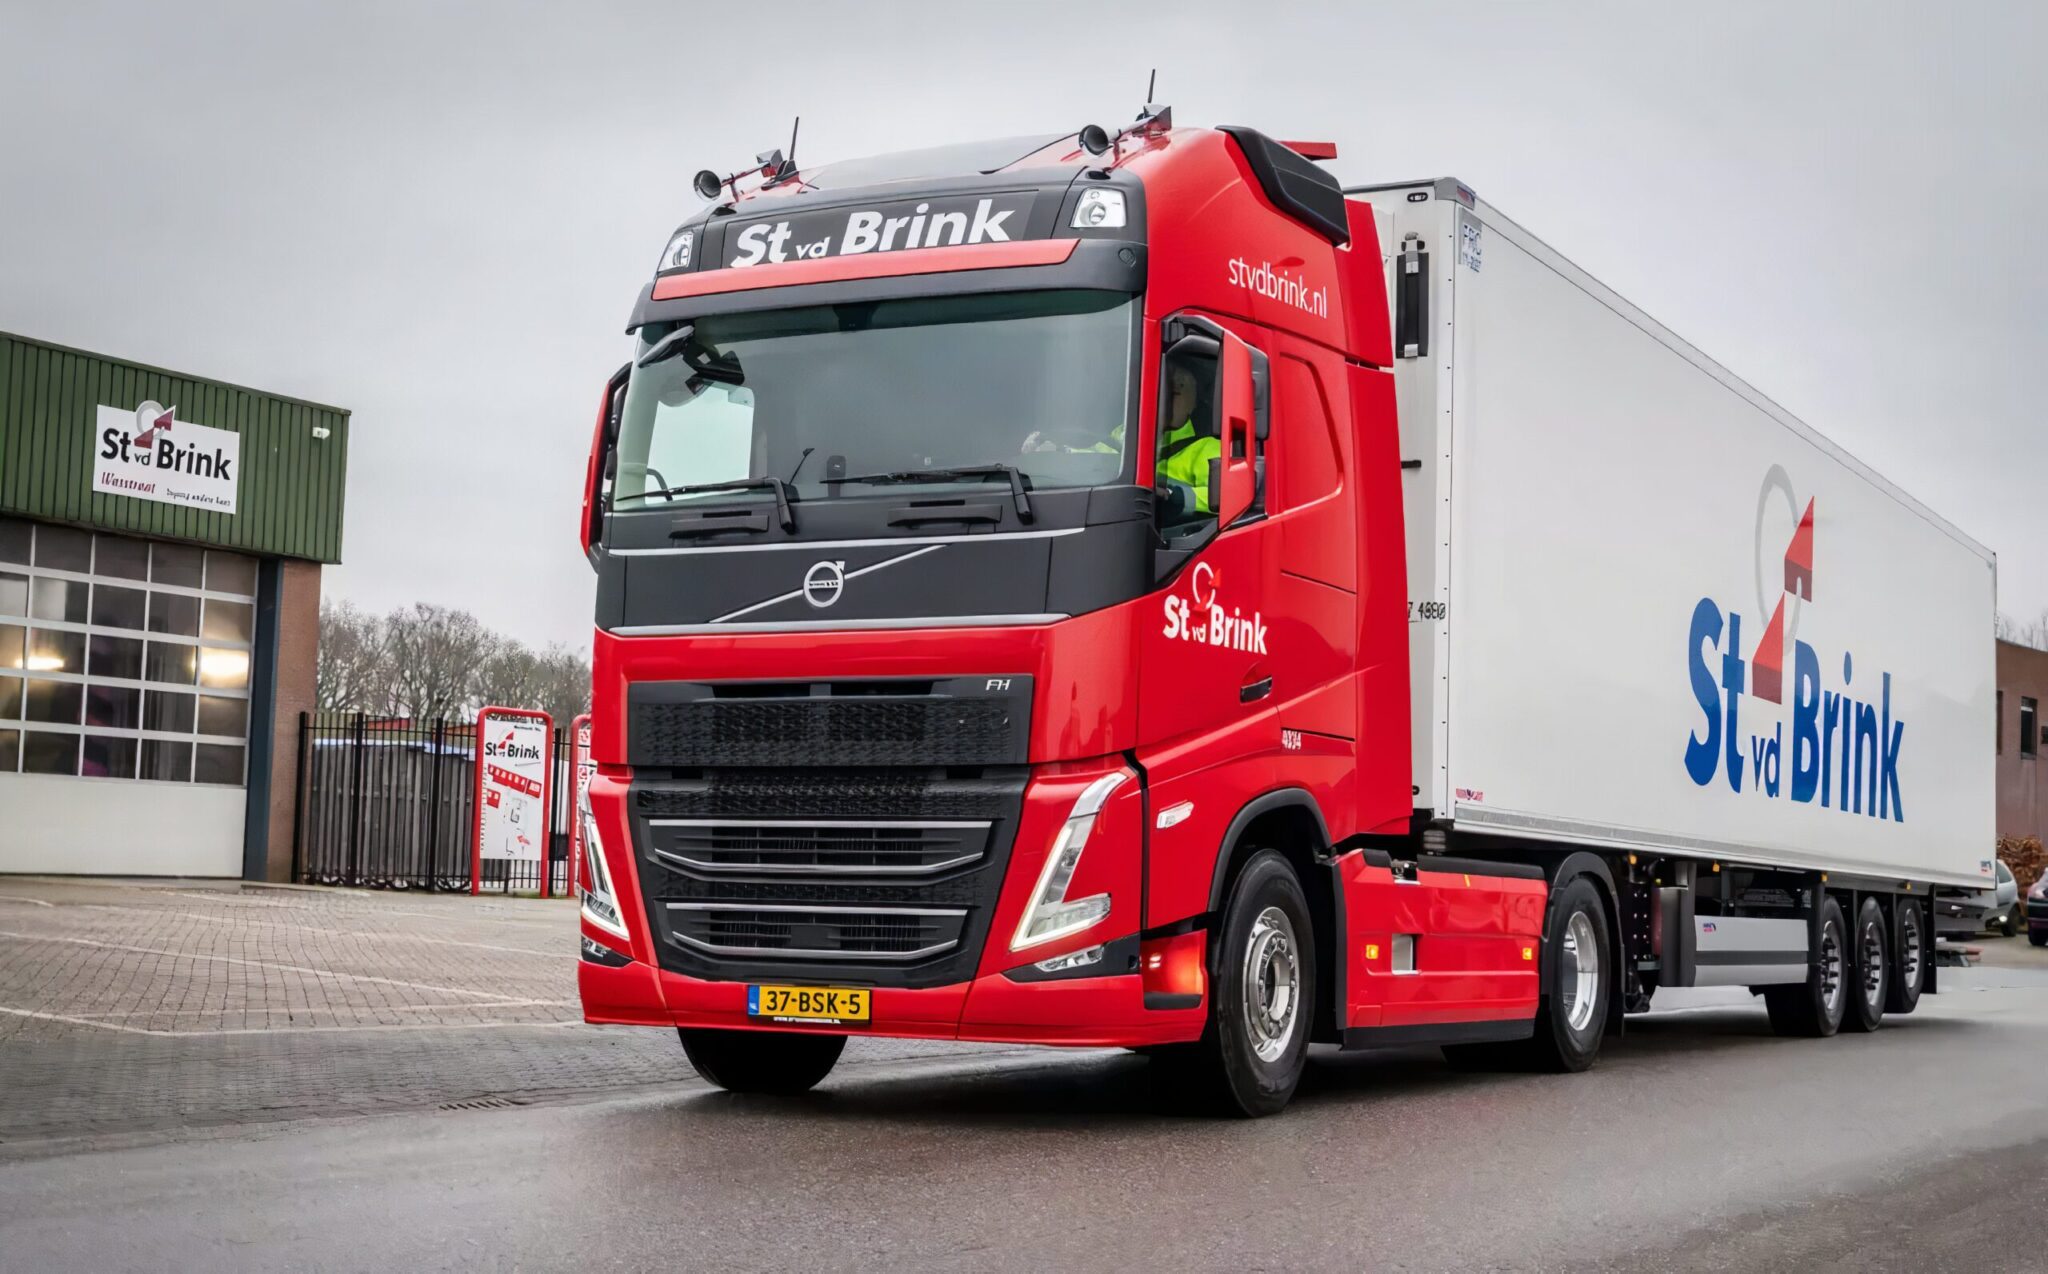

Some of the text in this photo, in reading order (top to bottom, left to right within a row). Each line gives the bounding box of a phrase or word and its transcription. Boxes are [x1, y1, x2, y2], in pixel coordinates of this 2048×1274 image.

[730, 198, 1016, 269] St vd Brink
[1228, 257, 1328, 320] stvdbrink.nl
[101, 427, 232, 481] St vd Brink
[1162, 594, 1268, 656] St vd Brink
[985, 679, 1013, 691] FH
[1684, 597, 1905, 823] St vd Brink
[485, 741, 540, 761] St Brink
[766, 990, 861, 1015] 37-BSK-5
